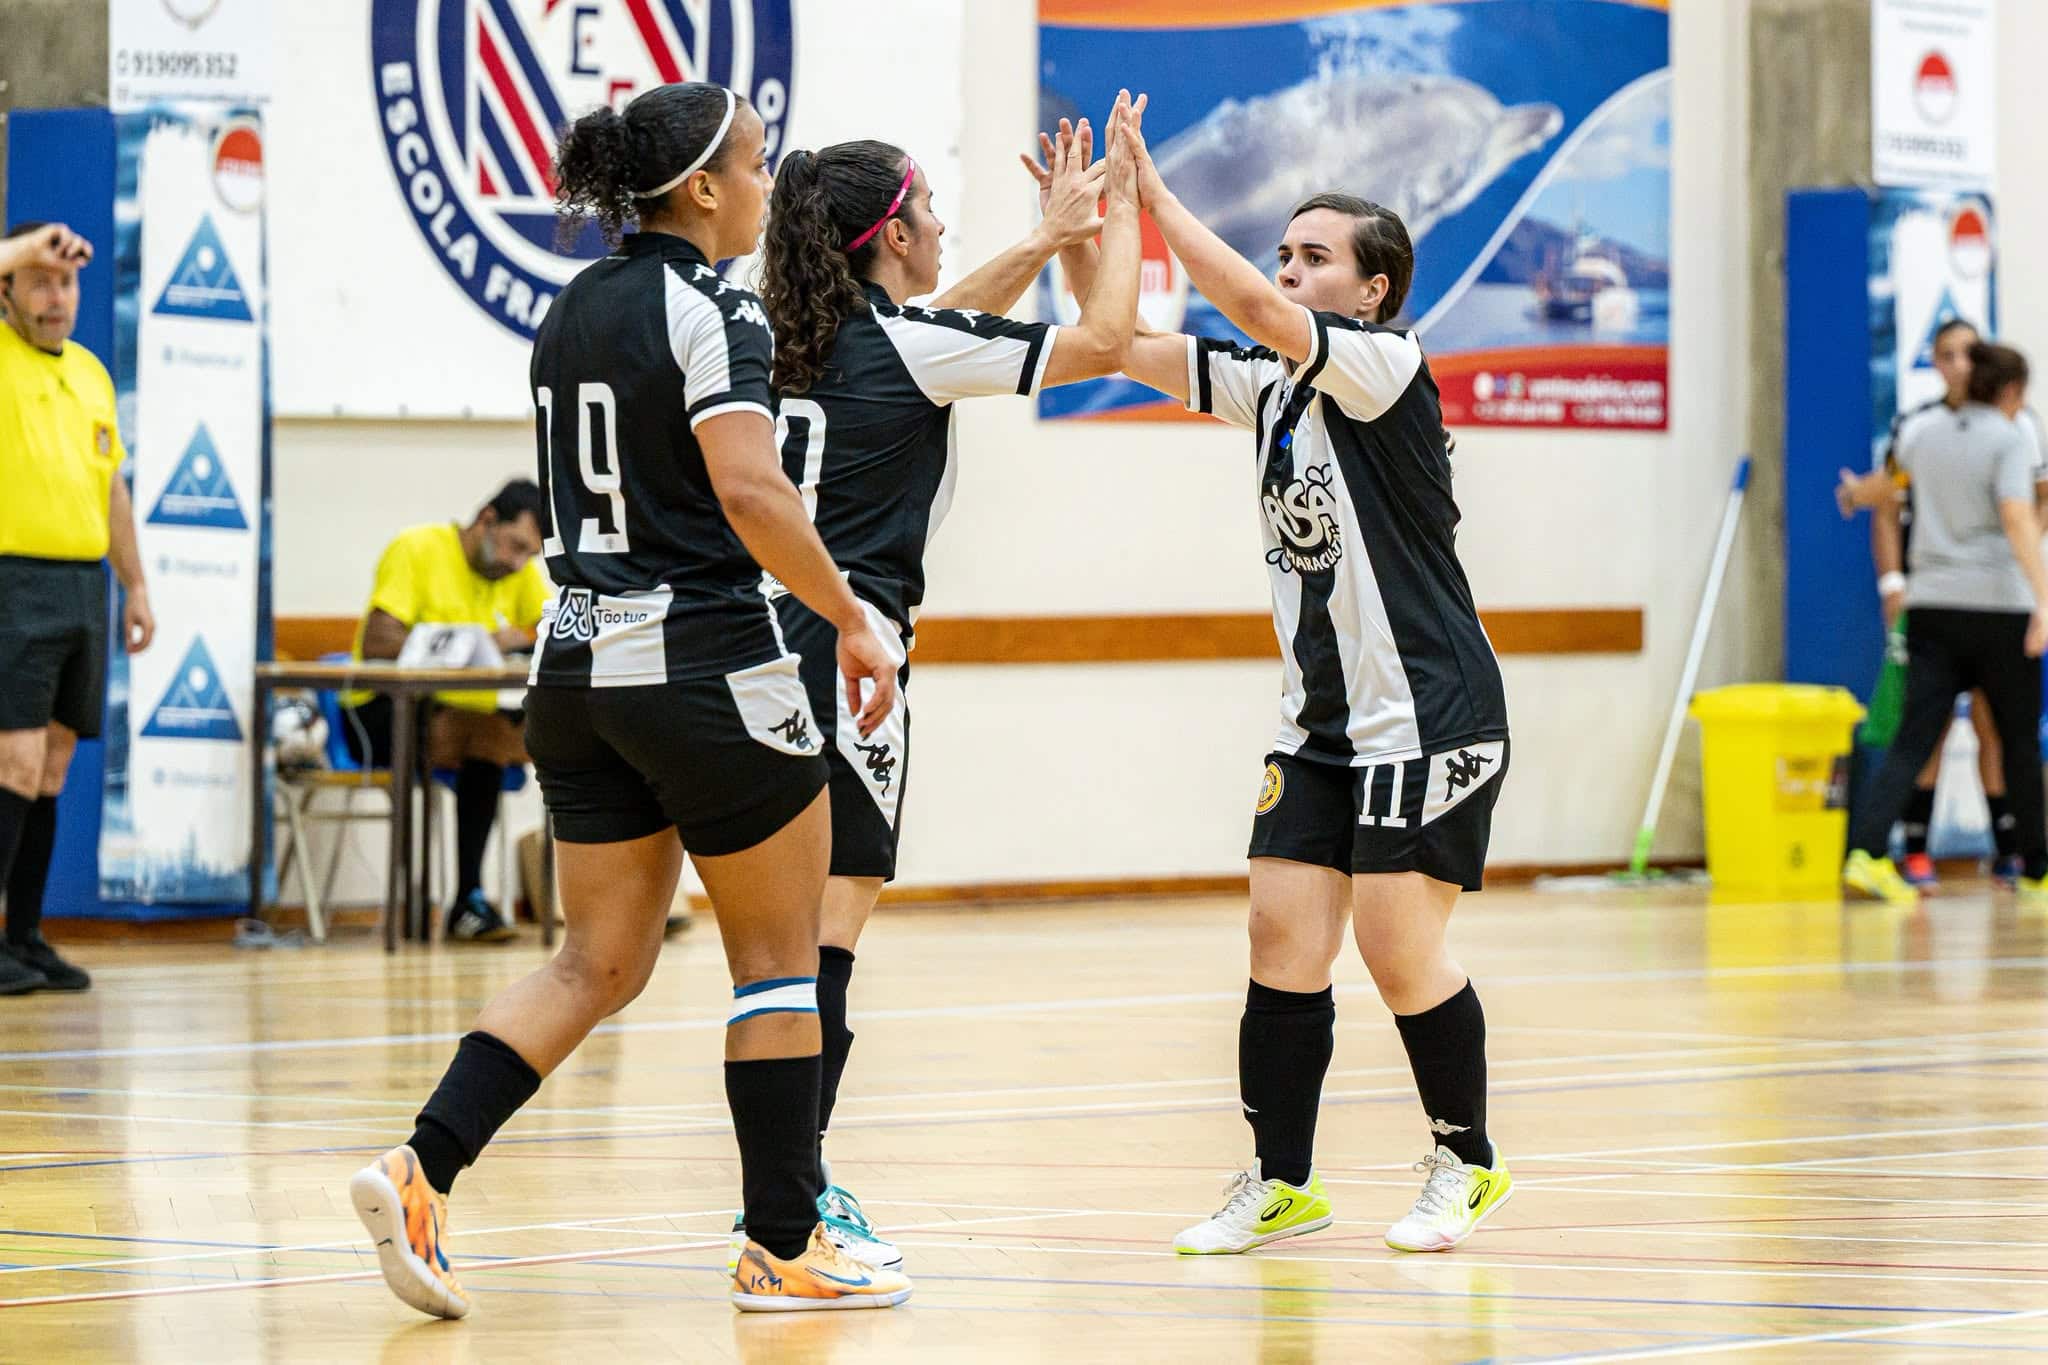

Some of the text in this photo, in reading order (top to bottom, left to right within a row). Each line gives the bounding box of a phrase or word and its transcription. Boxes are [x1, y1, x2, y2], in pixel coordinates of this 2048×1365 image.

[381, 61, 479, 280] ESCOLA
[537, 382, 630, 557] 19
[596, 609, 648, 624] Tão tua
[1358, 761, 1408, 828] 11
